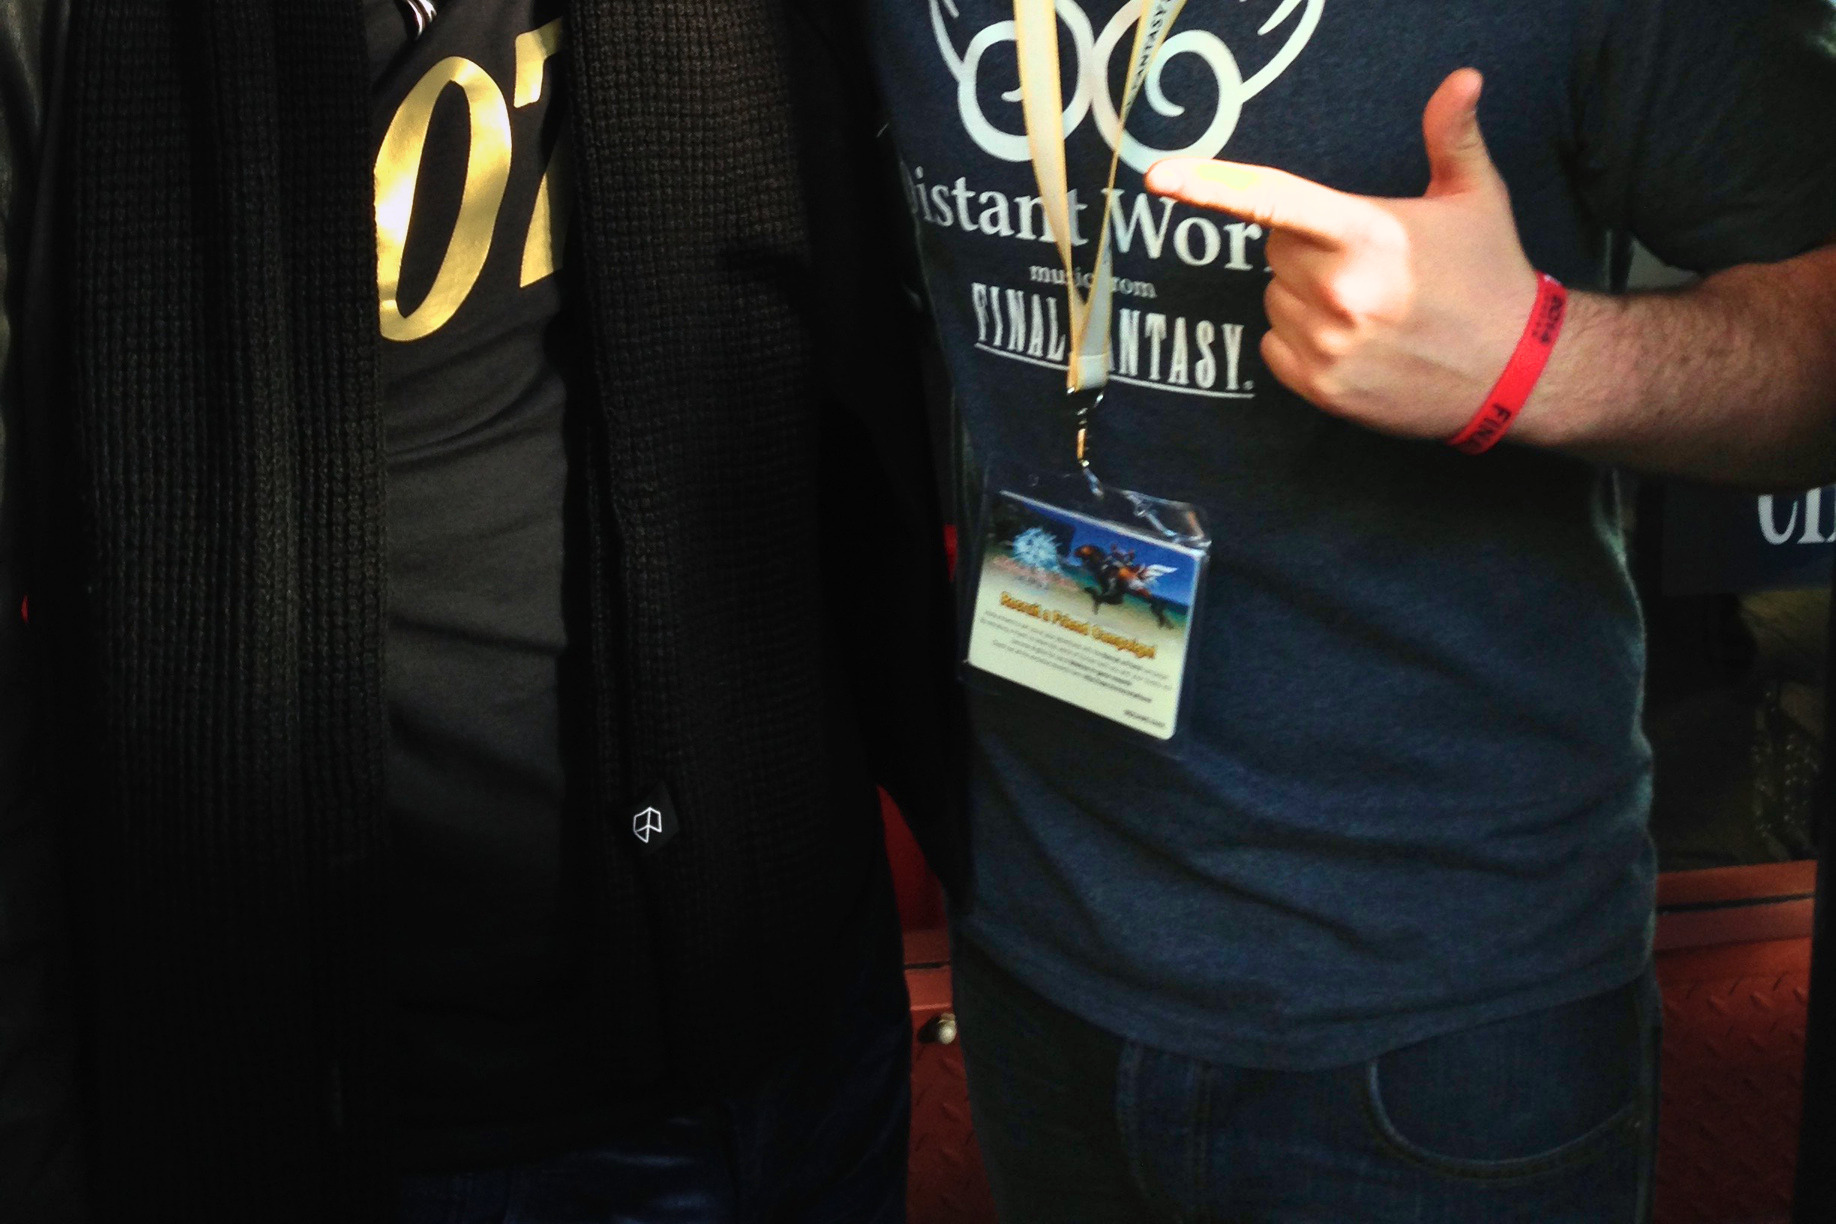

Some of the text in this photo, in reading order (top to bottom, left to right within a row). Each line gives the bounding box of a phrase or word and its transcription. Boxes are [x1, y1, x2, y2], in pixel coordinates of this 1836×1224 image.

[902, 164, 1089, 248] istant
[1028, 264, 1158, 299] muic rom
[971, 282, 1067, 362] FINAL
